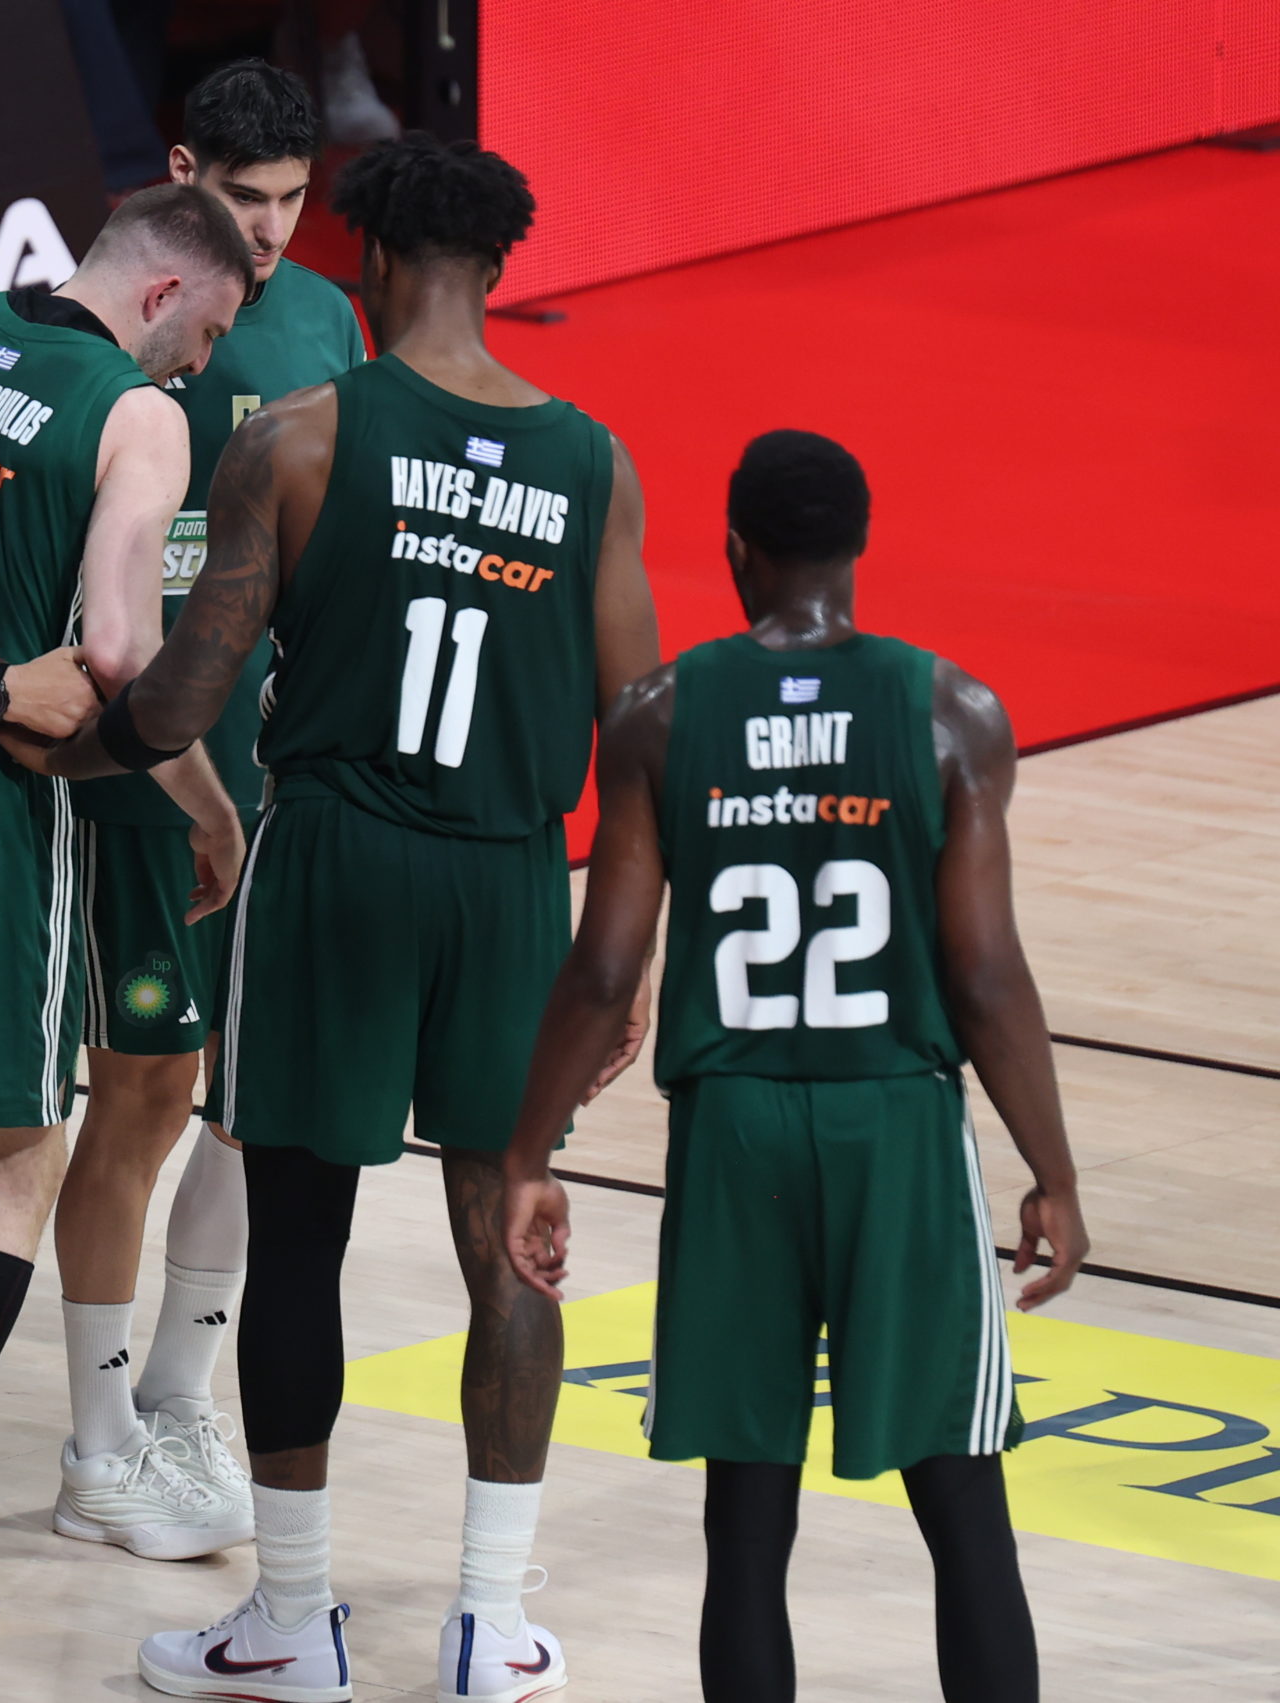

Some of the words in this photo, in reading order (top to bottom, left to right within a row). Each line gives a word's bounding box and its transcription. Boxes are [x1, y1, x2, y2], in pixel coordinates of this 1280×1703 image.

[391, 456, 569, 544] HAYES-DAVIS
[391, 520, 554, 592] instacar
[397, 597, 488, 768] 11
[745, 711, 853, 770] GRANT
[707, 785, 891, 828] instacar
[152, 957, 171, 974] bp
[710, 859, 891, 1030] 22
